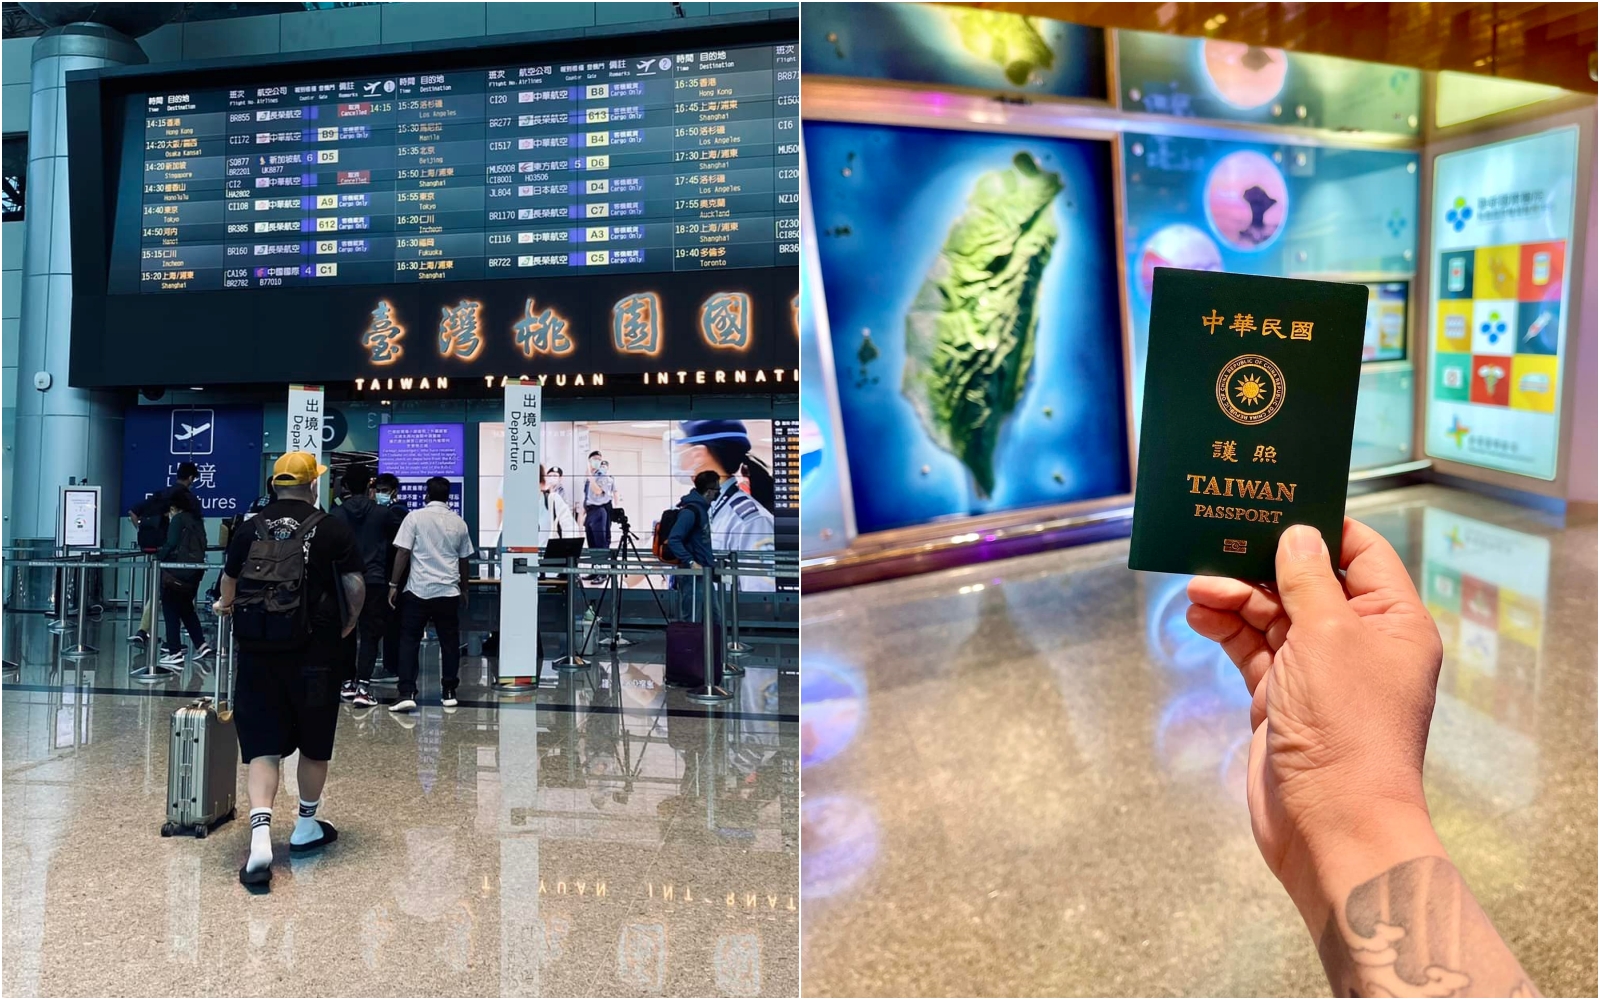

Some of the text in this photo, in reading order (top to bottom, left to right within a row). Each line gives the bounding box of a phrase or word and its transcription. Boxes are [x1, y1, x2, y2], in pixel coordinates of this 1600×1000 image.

[700, 52, 726, 61] 目的地
[519, 66, 552, 76] 航空公司
[675, 80, 698, 89] 16:35
[257, 86, 287, 96] 航空公司
[591, 87, 604, 95] B8
[490, 96, 507, 104] CI20
[370, 104, 391, 112] 14:15
[398, 102, 419, 110] 15:25
[675, 104, 698, 113] 16:45
[230, 114, 250, 122] BR855
[147, 119, 166, 127] 14:15
[490, 118, 511, 127] BR277
[778, 121, 793, 130] CI6
[322, 130, 334, 139] B9
[675, 128, 698, 137] 16:50
[230, 136, 249, 144] CI172
[591, 135, 604, 143] B4
[715, 136, 740, 144] Angeles
[146, 141, 165, 149] 14:20
[490, 142, 511, 150] CI517
[398, 147, 419, 155] 15:35
[322, 152, 334, 161] D5
[675, 152, 698, 160] 17:30
[145, 163, 164, 171] 14:20
[591, 159, 604, 167] D6
[700, 162, 729, 170] Shanghai
[490, 165, 515, 174] MU5008
[398, 170, 419, 178] 15:50
[490, 176, 512, 184] CI8001
[675, 176, 698, 185] 17:45
[144, 185, 164, 193] 14:30
[591, 183, 604, 191] D4
[715, 185, 741, 193] Angeles
[489, 188, 511, 197] JL804
[398, 193, 418, 201] 15:55
[228, 202, 248, 210] CI108
[321, 198, 333, 206] A9
[675, 201, 698, 209] 17:55
[144, 206, 163, 214] 14:40
[591, 206, 604, 214] C7
[489, 211, 515, 220] BR1170
[319, 220, 335, 228] 612
[398, 216, 419, 224] 16:20
[143, 228, 162, 236] 14:50
[228, 225, 248, 233] BR385
[675, 225, 699, 233] 18:20
[591, 230, 604, 238] A3
[397, 239, 418, 247] 16:30
[489, 235, 511, 244] CI116
[228, 247, 248, 255] BR160
[320, 243, 333, 251] C6
[142, 250, 162, 259] 15:15
[676, 249, 699, 258] 19:40
[591, 254, 604, 262] C5
[397, 262, 418, 270] 16:30
[489, 258, 510, 267] BR722
[227, 269, 247, 278] CA196
[320, 266, 332, 274] C1
[142, 272, 161, 281] 15:20
[227, 279, 248, 287] BR2782
[360, 291, 799, 365] 臺灣桃園國
[1201, 309, 1314, 342] 中華民國
[355, 377, 448, 390] TAIWAN
[304, 398, 319, 458] 出境入
[523, 393, 536, 464] 出境入口
[508, 411, 520, 471] Departure
[1212, 440, 1277, 463] 護照
[1187, 474, 1297, 502] TAIWAN
[1194, 504, 1283, 524] PASSPORT
